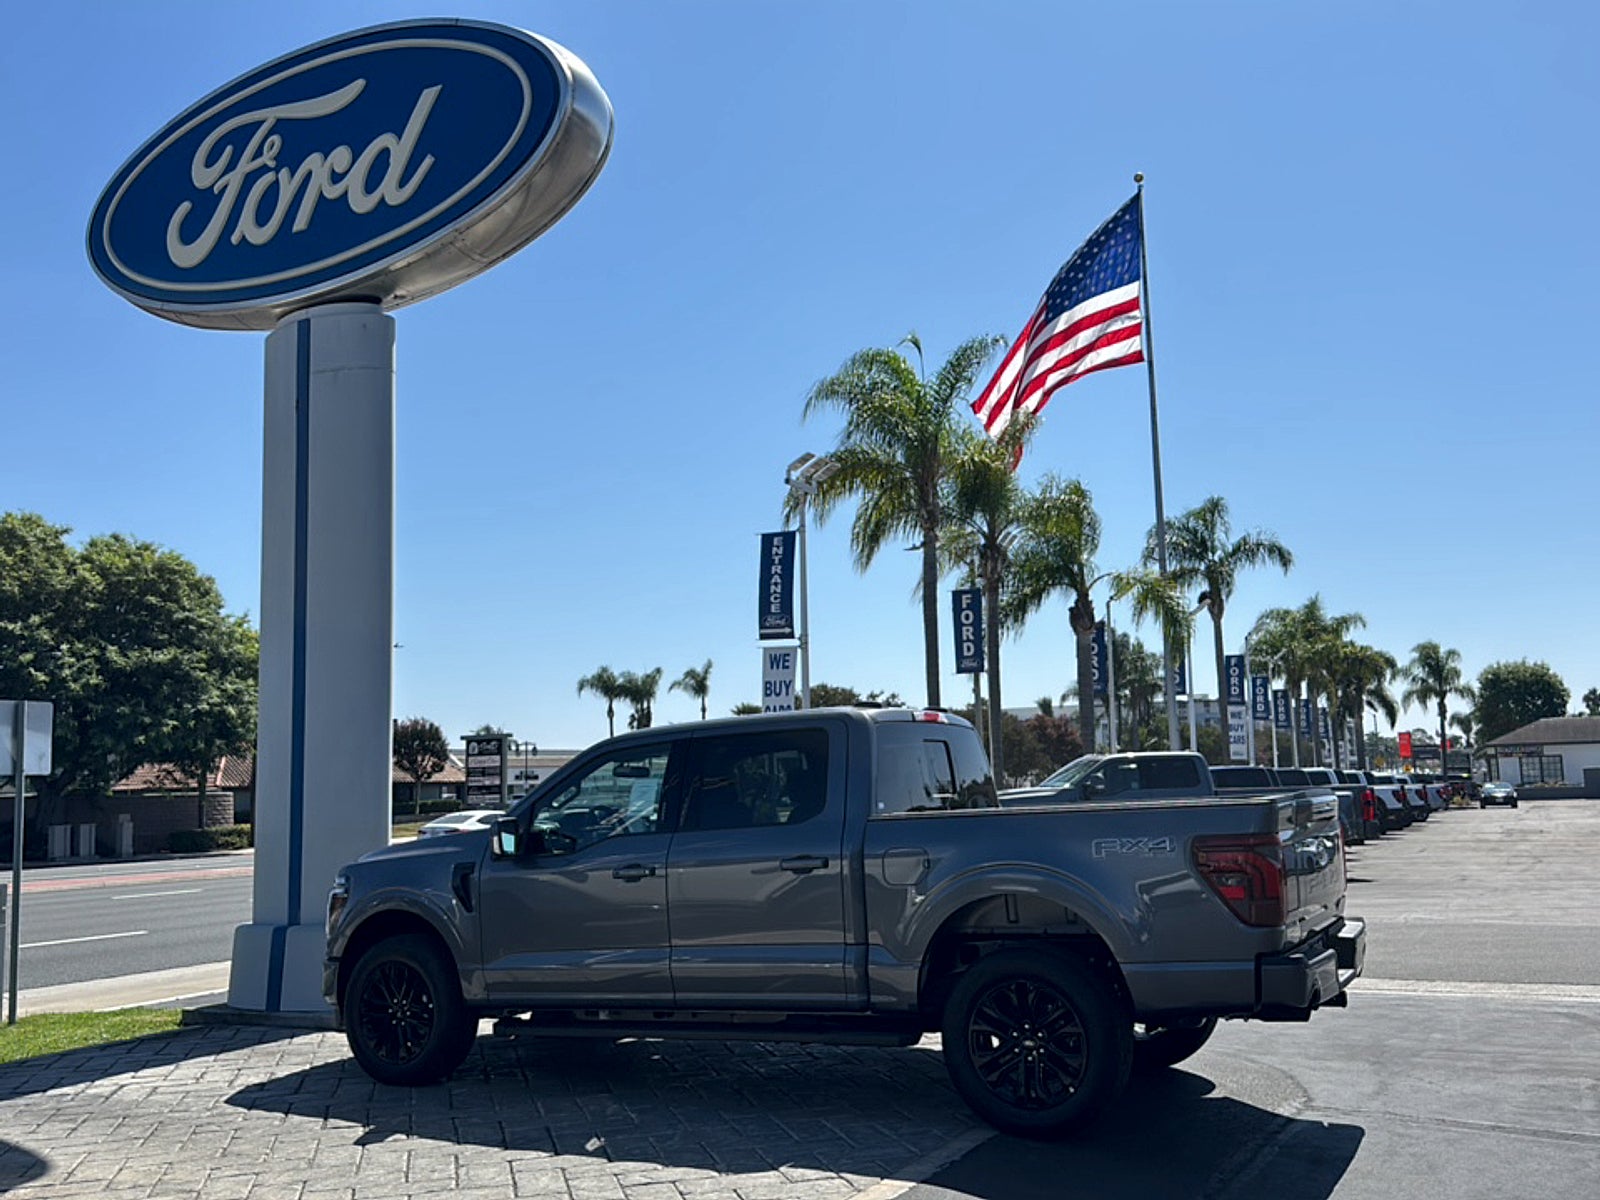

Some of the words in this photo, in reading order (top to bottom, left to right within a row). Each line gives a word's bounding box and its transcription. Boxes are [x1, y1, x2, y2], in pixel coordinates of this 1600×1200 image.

[167, 78, 442, 269] Ford
[770, 537, 783, 613] ENTRANCE
[961, 594, 975, 657] FORD
[769, 653, 791, 670] WE
[1230, 657, 1240, 695] FORD
[765, 681, 792, 697] BUY
[1256, 678, 1265, 711] FORD
[1091, 836, 1176, 859] FX4
